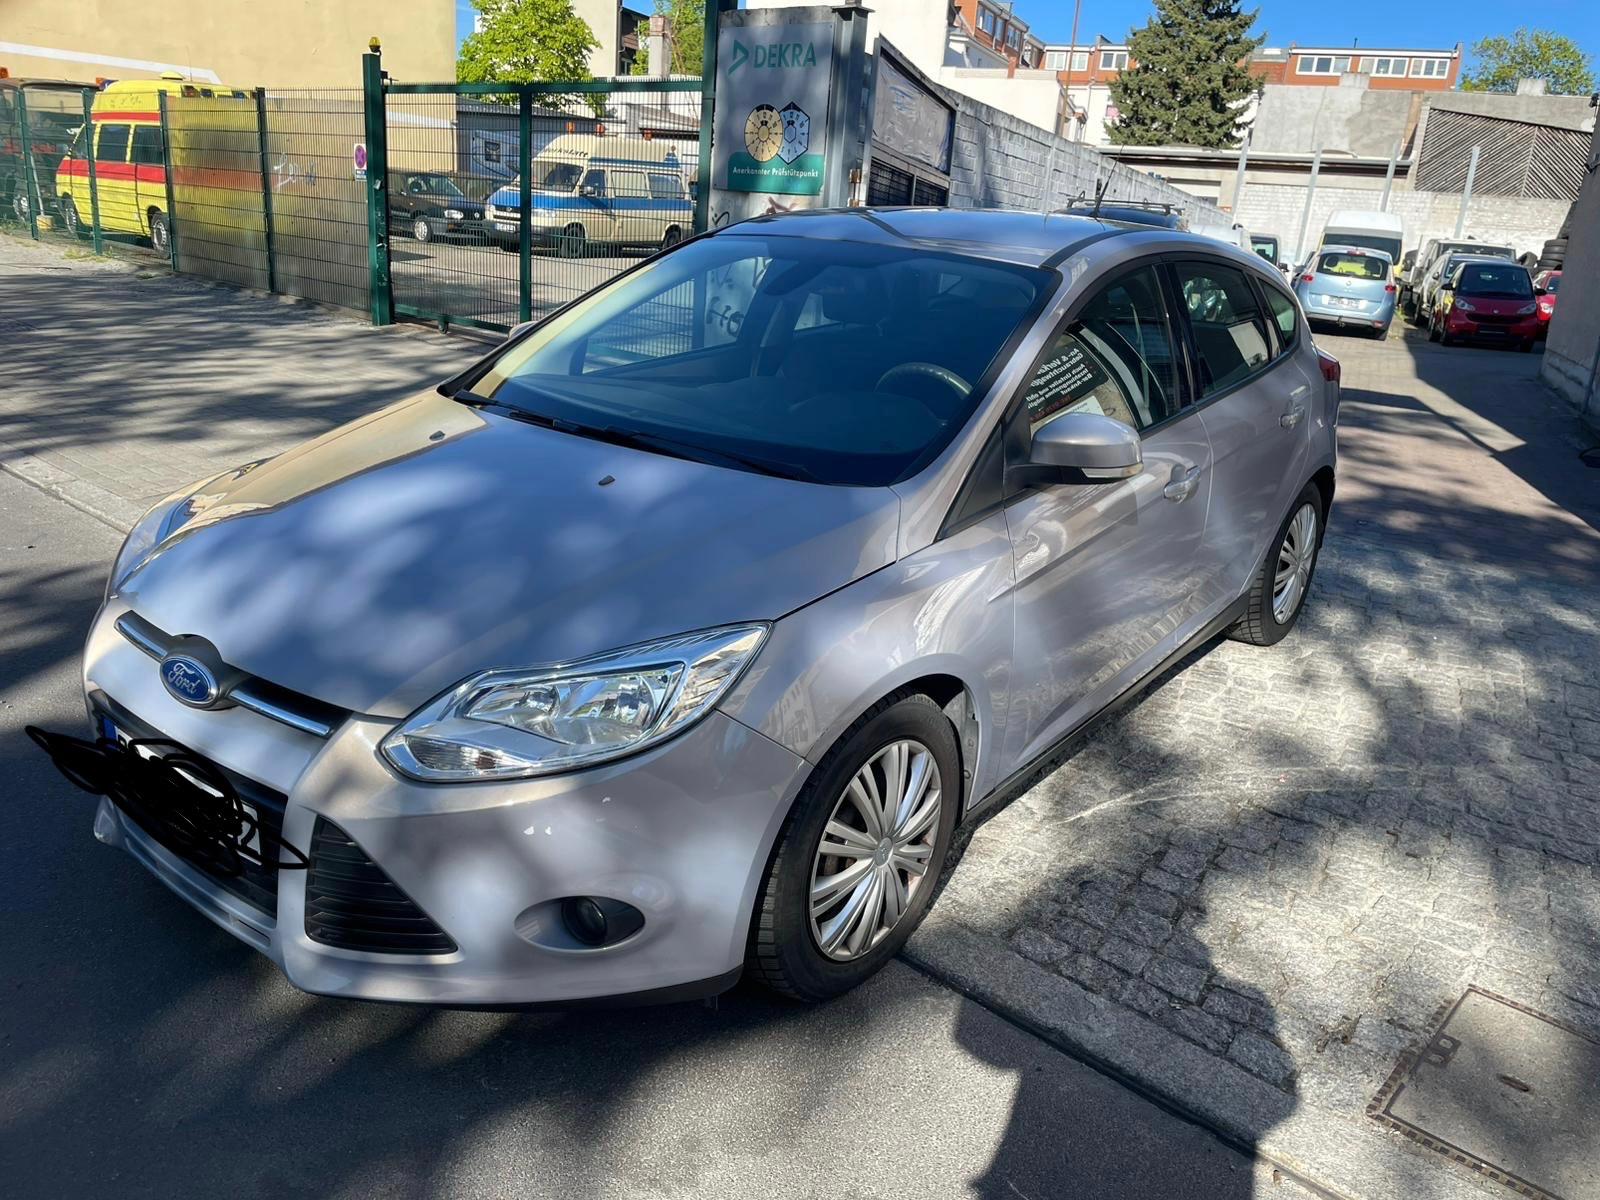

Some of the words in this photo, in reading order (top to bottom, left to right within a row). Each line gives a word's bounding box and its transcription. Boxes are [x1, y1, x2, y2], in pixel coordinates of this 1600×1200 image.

[753, 41, 817, 68] DEKRA
[732, 166, 770, 176] Anerkannter
[771, 167, 819, 179] Prüfstützpunkt
[168, 662, 201, 694] Ford
